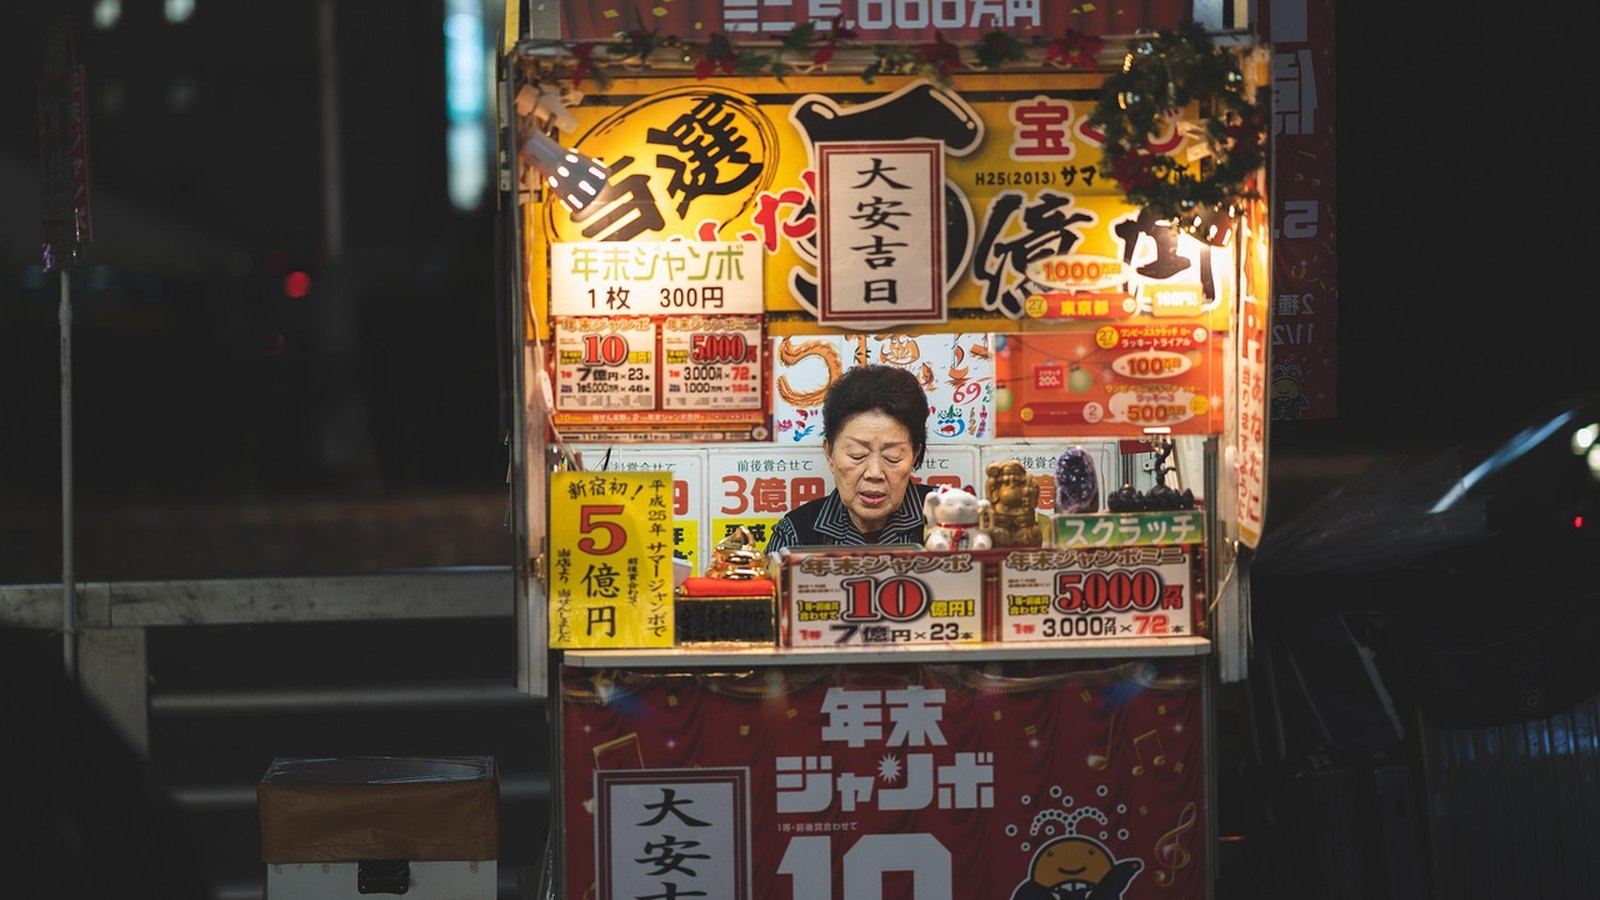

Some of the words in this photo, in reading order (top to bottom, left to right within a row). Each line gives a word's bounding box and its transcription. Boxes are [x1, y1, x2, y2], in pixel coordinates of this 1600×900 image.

[976, 172, 1055, 185] H25(2013)
[850, 158, 912, 304] 大安吉日
[571, 245, 744, 282] 年末ジャンボ
[588, 286, 630, 310] 1枚
[660, 286, 723, 309] 300円
[1028, 298, 1044, 311] 27
[1060, 299, 1110, 316] 東京都
[1098, 329, 1114, 342] 27
[1121, 338, 1192, 348] ラッキートライアル
[582, 333, 629, 367] 10
[737, 459, 814, 473] 前後賞合せて
[568, 476, 644, 501] 新宿初!
[720, 475, 826, 515] 3億円
[1064, 515, 1196, 546] スクラッチ
[646, 479, 669, 638] 平成25年サマージャンボで
[801, 554, 973, 575] 年末ジャンボ
[1006, 548, 1186, 570] 年末ジャンボミニ
[577, 504, 628, 639] 5億円
[841, 575, 930, 623] 10
[929, 600, 975, 617] 億円!
[820, 685, 948, 748] 年末
[776, 752, 995, 814] ジャンボ
